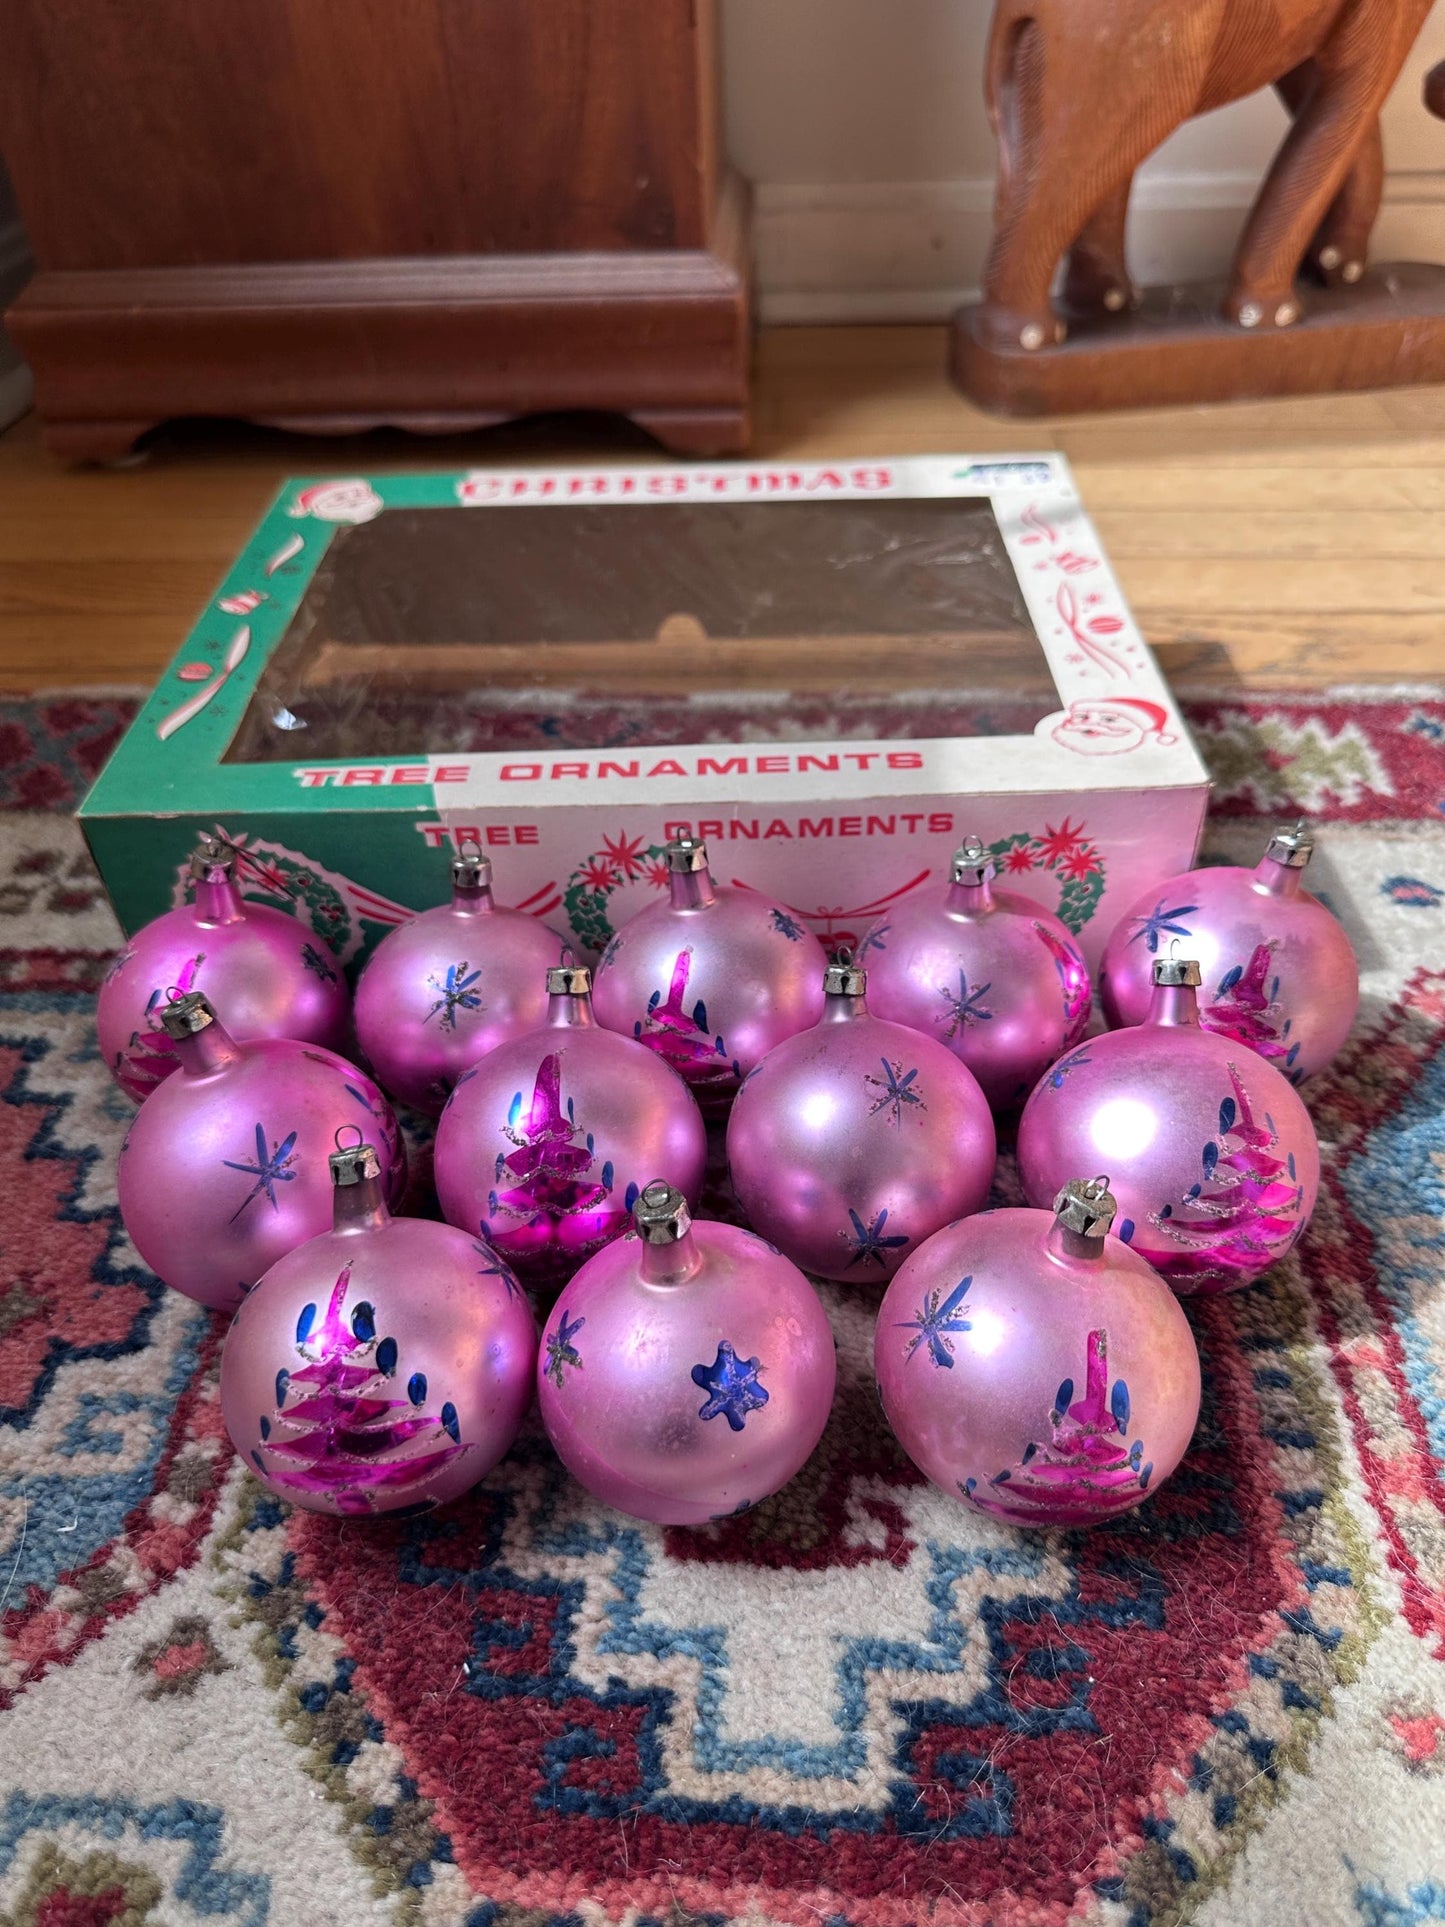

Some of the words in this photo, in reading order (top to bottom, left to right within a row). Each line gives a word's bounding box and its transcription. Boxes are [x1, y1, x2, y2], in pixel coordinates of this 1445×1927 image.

[459, 468, 892, 500] CHRISTMAS
[298, 765, 470, 788] TREE
[499, 751, 924, 782] ORNAMENTS
[421, 823, 540, 848] TREE
[664, 812, 955, 843] ORNAMENTS
